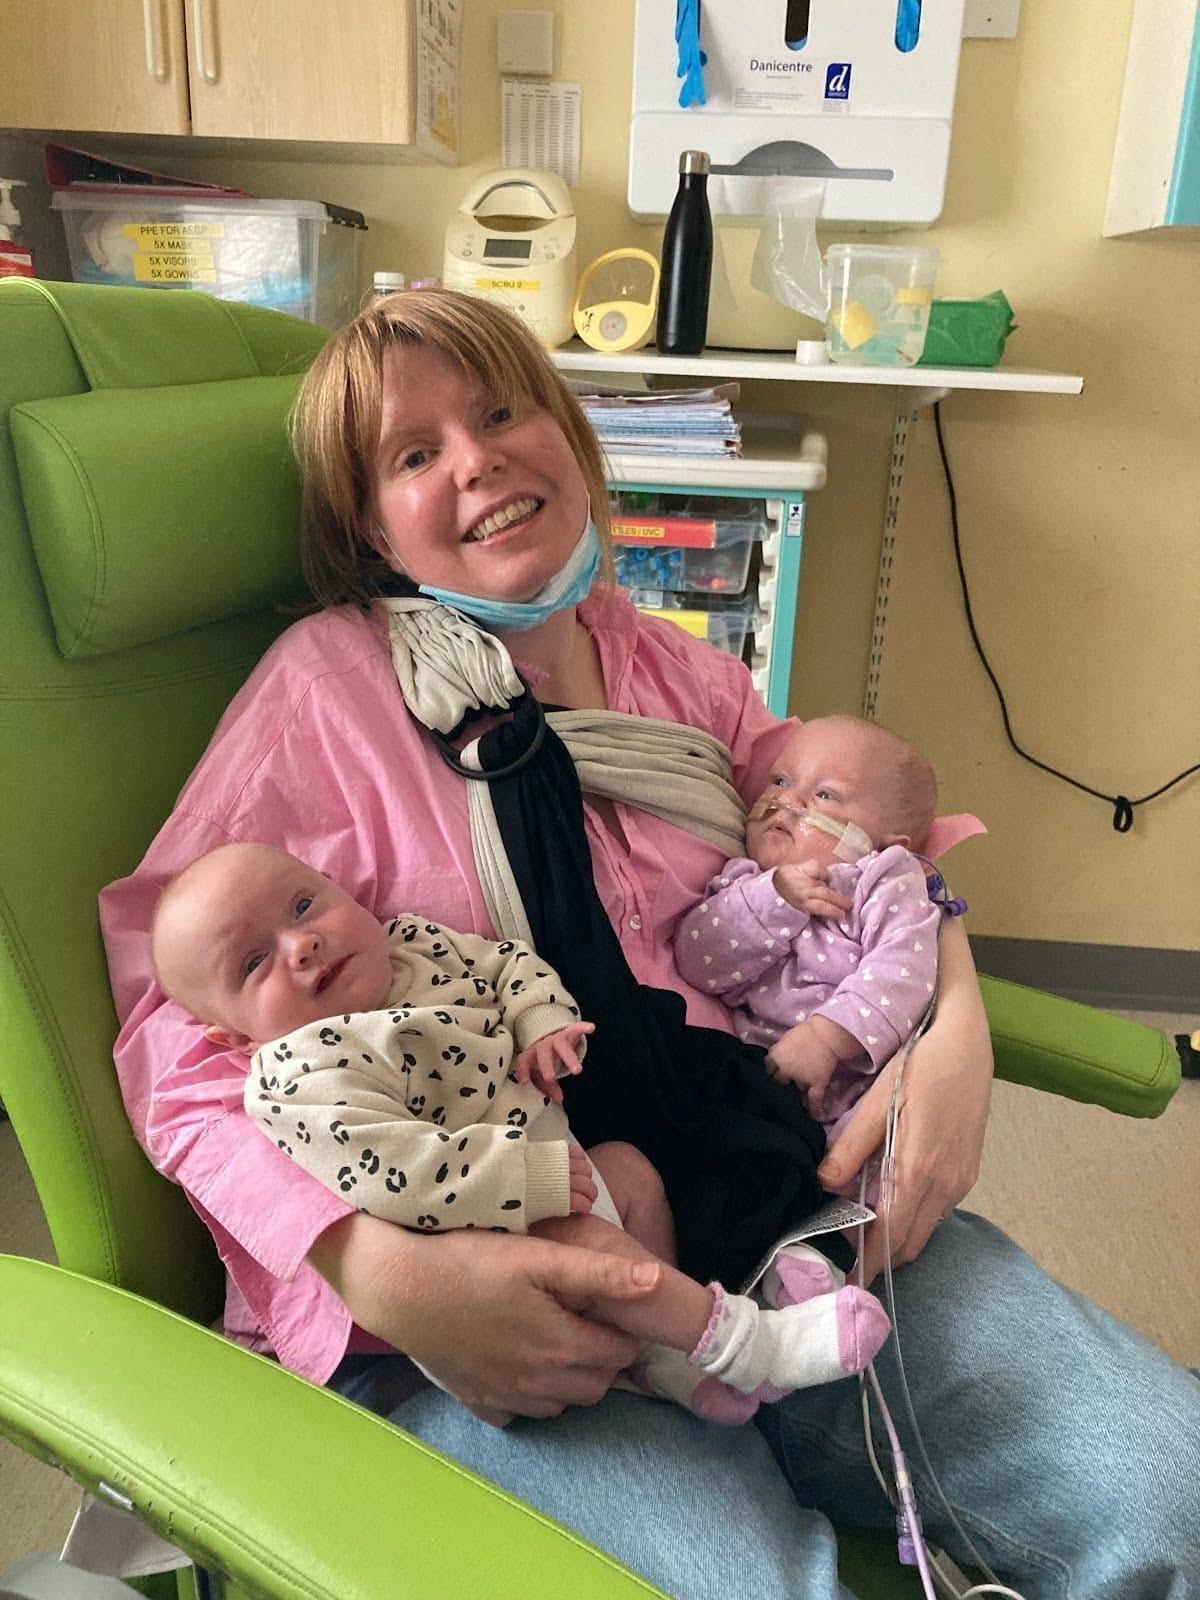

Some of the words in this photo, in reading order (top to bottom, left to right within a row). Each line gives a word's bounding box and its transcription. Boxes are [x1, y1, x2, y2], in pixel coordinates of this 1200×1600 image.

[750, 60, 813, 72] Danicentre
[140, 226, 158, 235] PPE
[161, 226, 180, 235] FOR
[154, 241, 165, 249] 5X
[168, 240, 194, 250] MASK
[149, 256, 160, 265] 5X
[163, 256, 197, 266] VISORS
[151, 269, 162, 279] 5X
[164, 269, 200, 280] GOWNS
